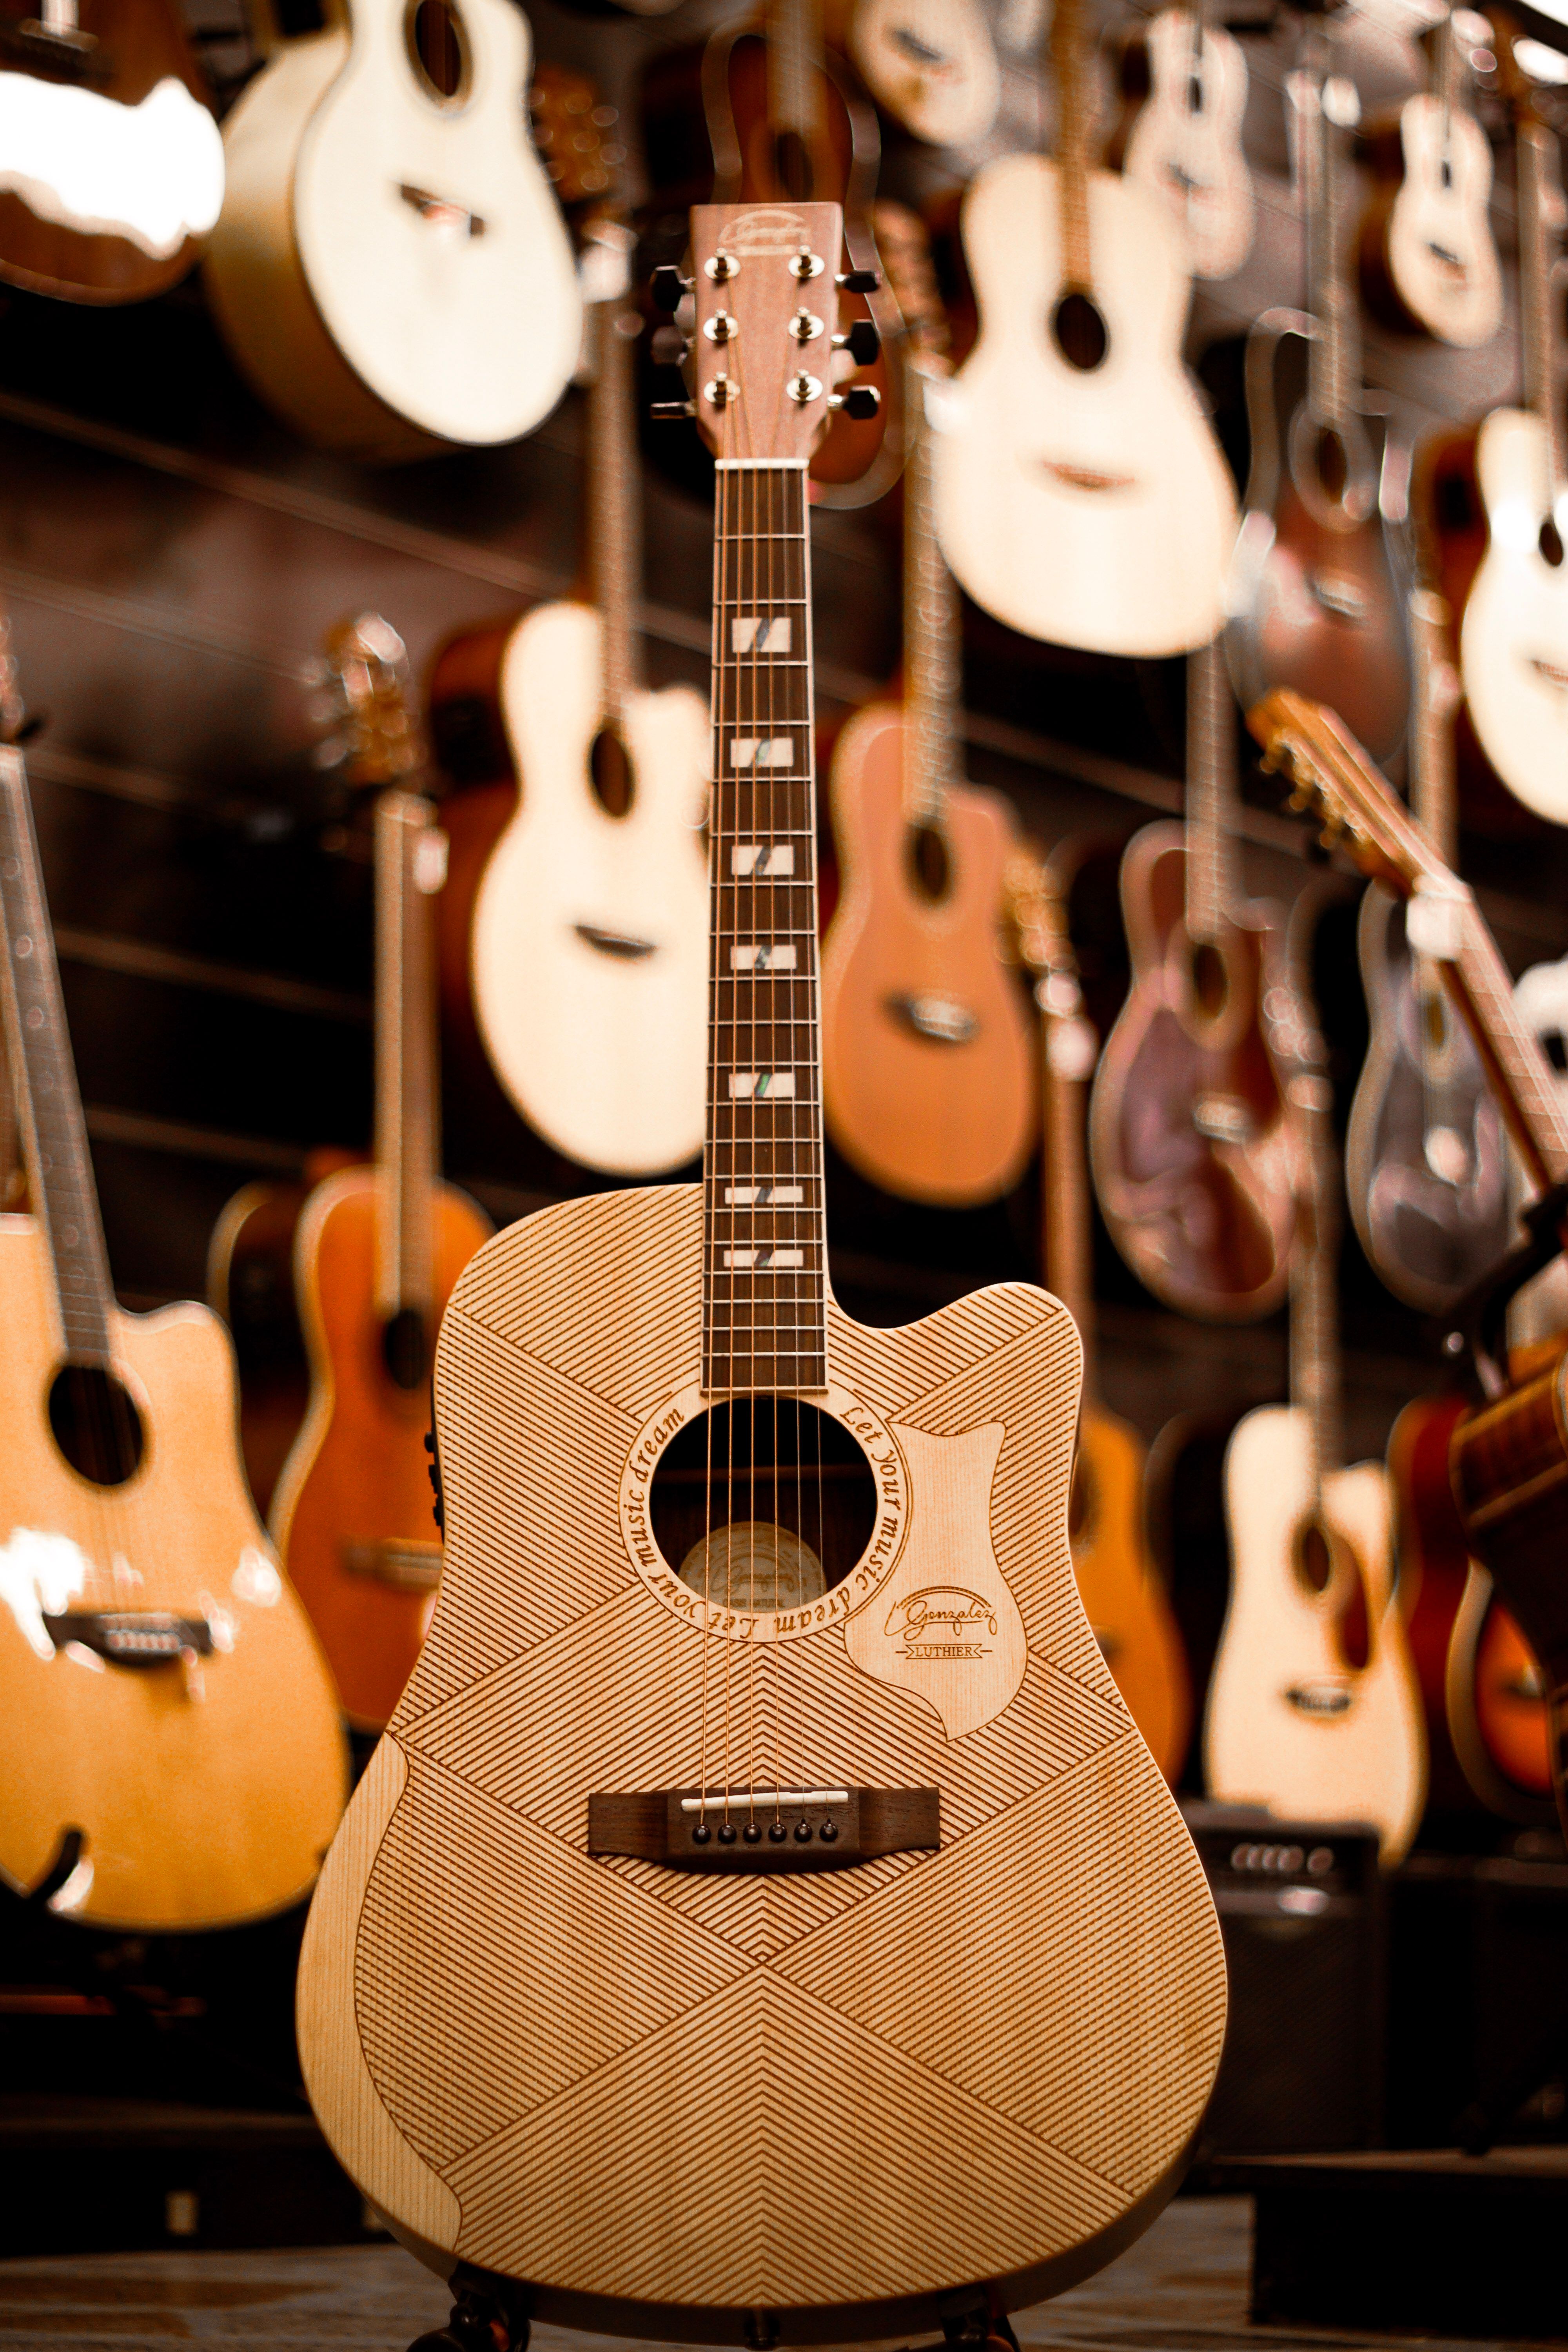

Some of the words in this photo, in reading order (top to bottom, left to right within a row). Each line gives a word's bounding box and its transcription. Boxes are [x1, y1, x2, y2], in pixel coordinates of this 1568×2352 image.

[629, 1408, 684, 1483] dream
[839, 1407, 883, 1443] Let
[871, 1450, 901, 1510] your
[624, 1490, 657, 1567] music
[856, 1517, 898, 1590] music
[647, 1574, 706, 1618] your
[774, 1587, 850, 1633] dream
[708, 1612, 759, 1639] Let
[884, 1600, 998, 1641] Gonzalez
[915, 1646, 973, 1657] LUTHIER
